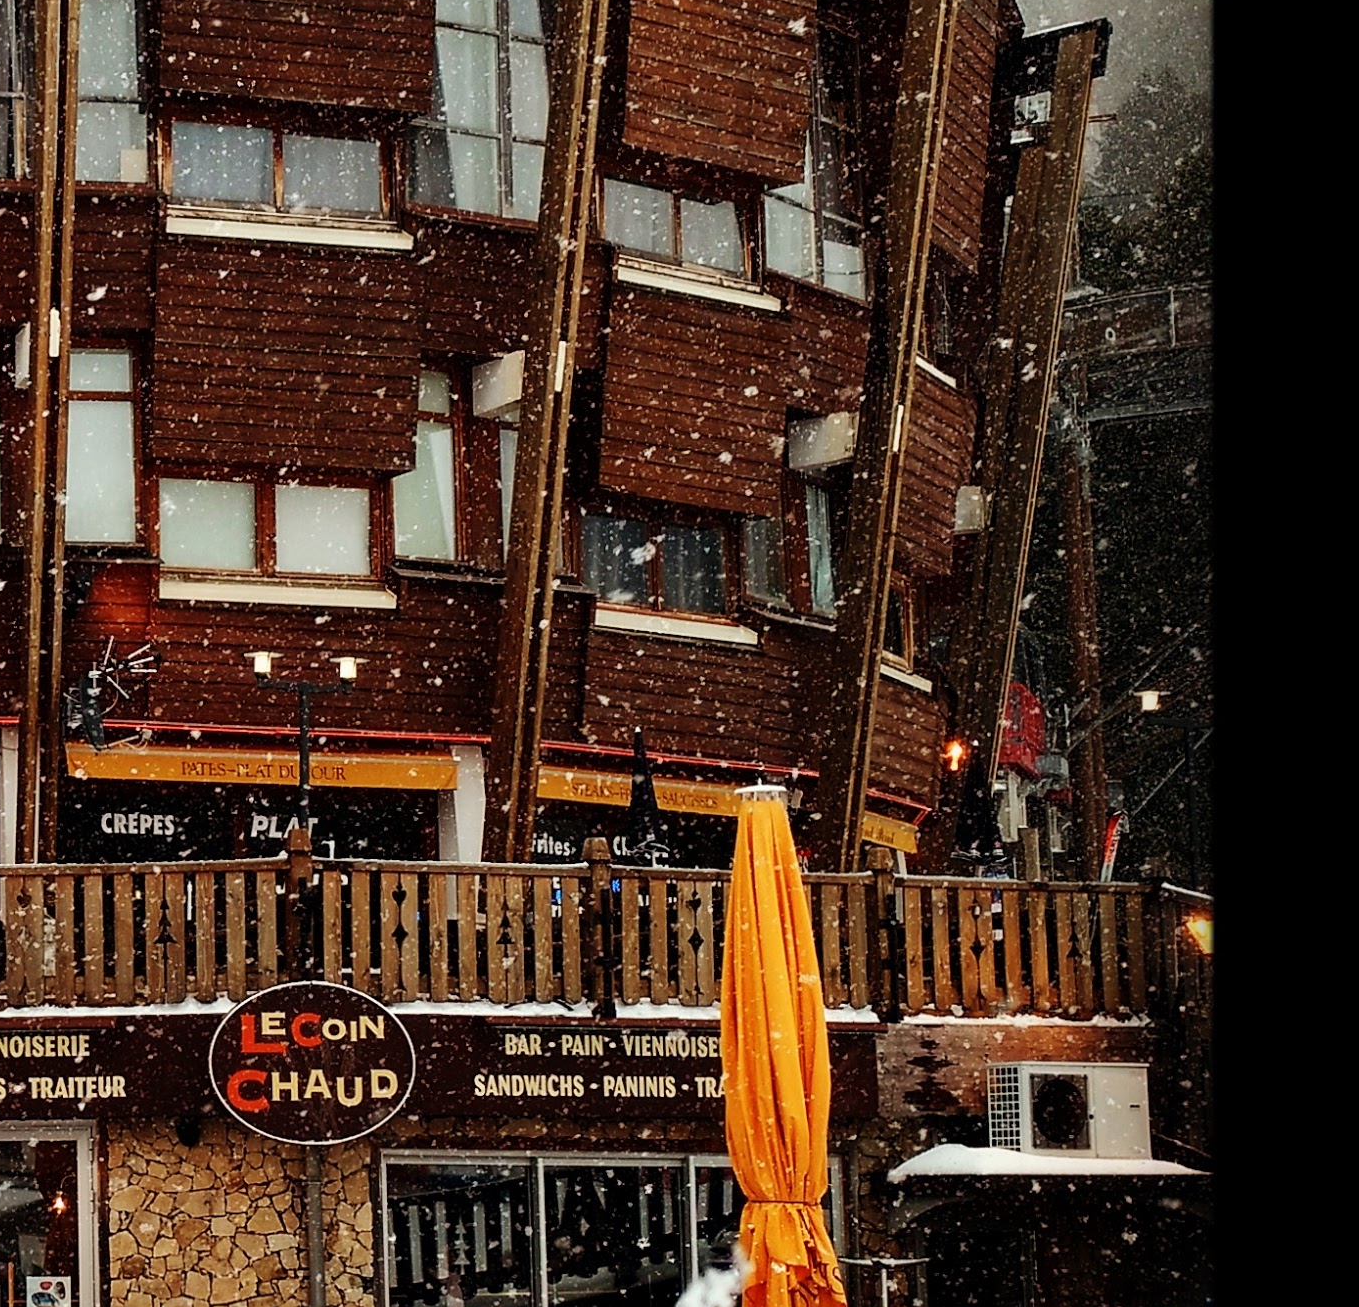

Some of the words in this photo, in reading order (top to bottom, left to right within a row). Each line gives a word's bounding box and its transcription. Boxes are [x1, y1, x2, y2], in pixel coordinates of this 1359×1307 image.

[311, 766, 347, 781] OUR
[240, 1011, 287, 1053] LE
[504, 1033, 543, 1056] BAR
[561, 1034, 605, 1057] PAIN
[622, 1035, 723, 1058] VIENNOISE
[28, 1075, 127, 1100] TRAITEUR
[226, 1069, 399, 1113] CHAUD
[473, 1073, 585, 1098] SANDWICHS
[603, 1075, 677, 1098] PANINIS
